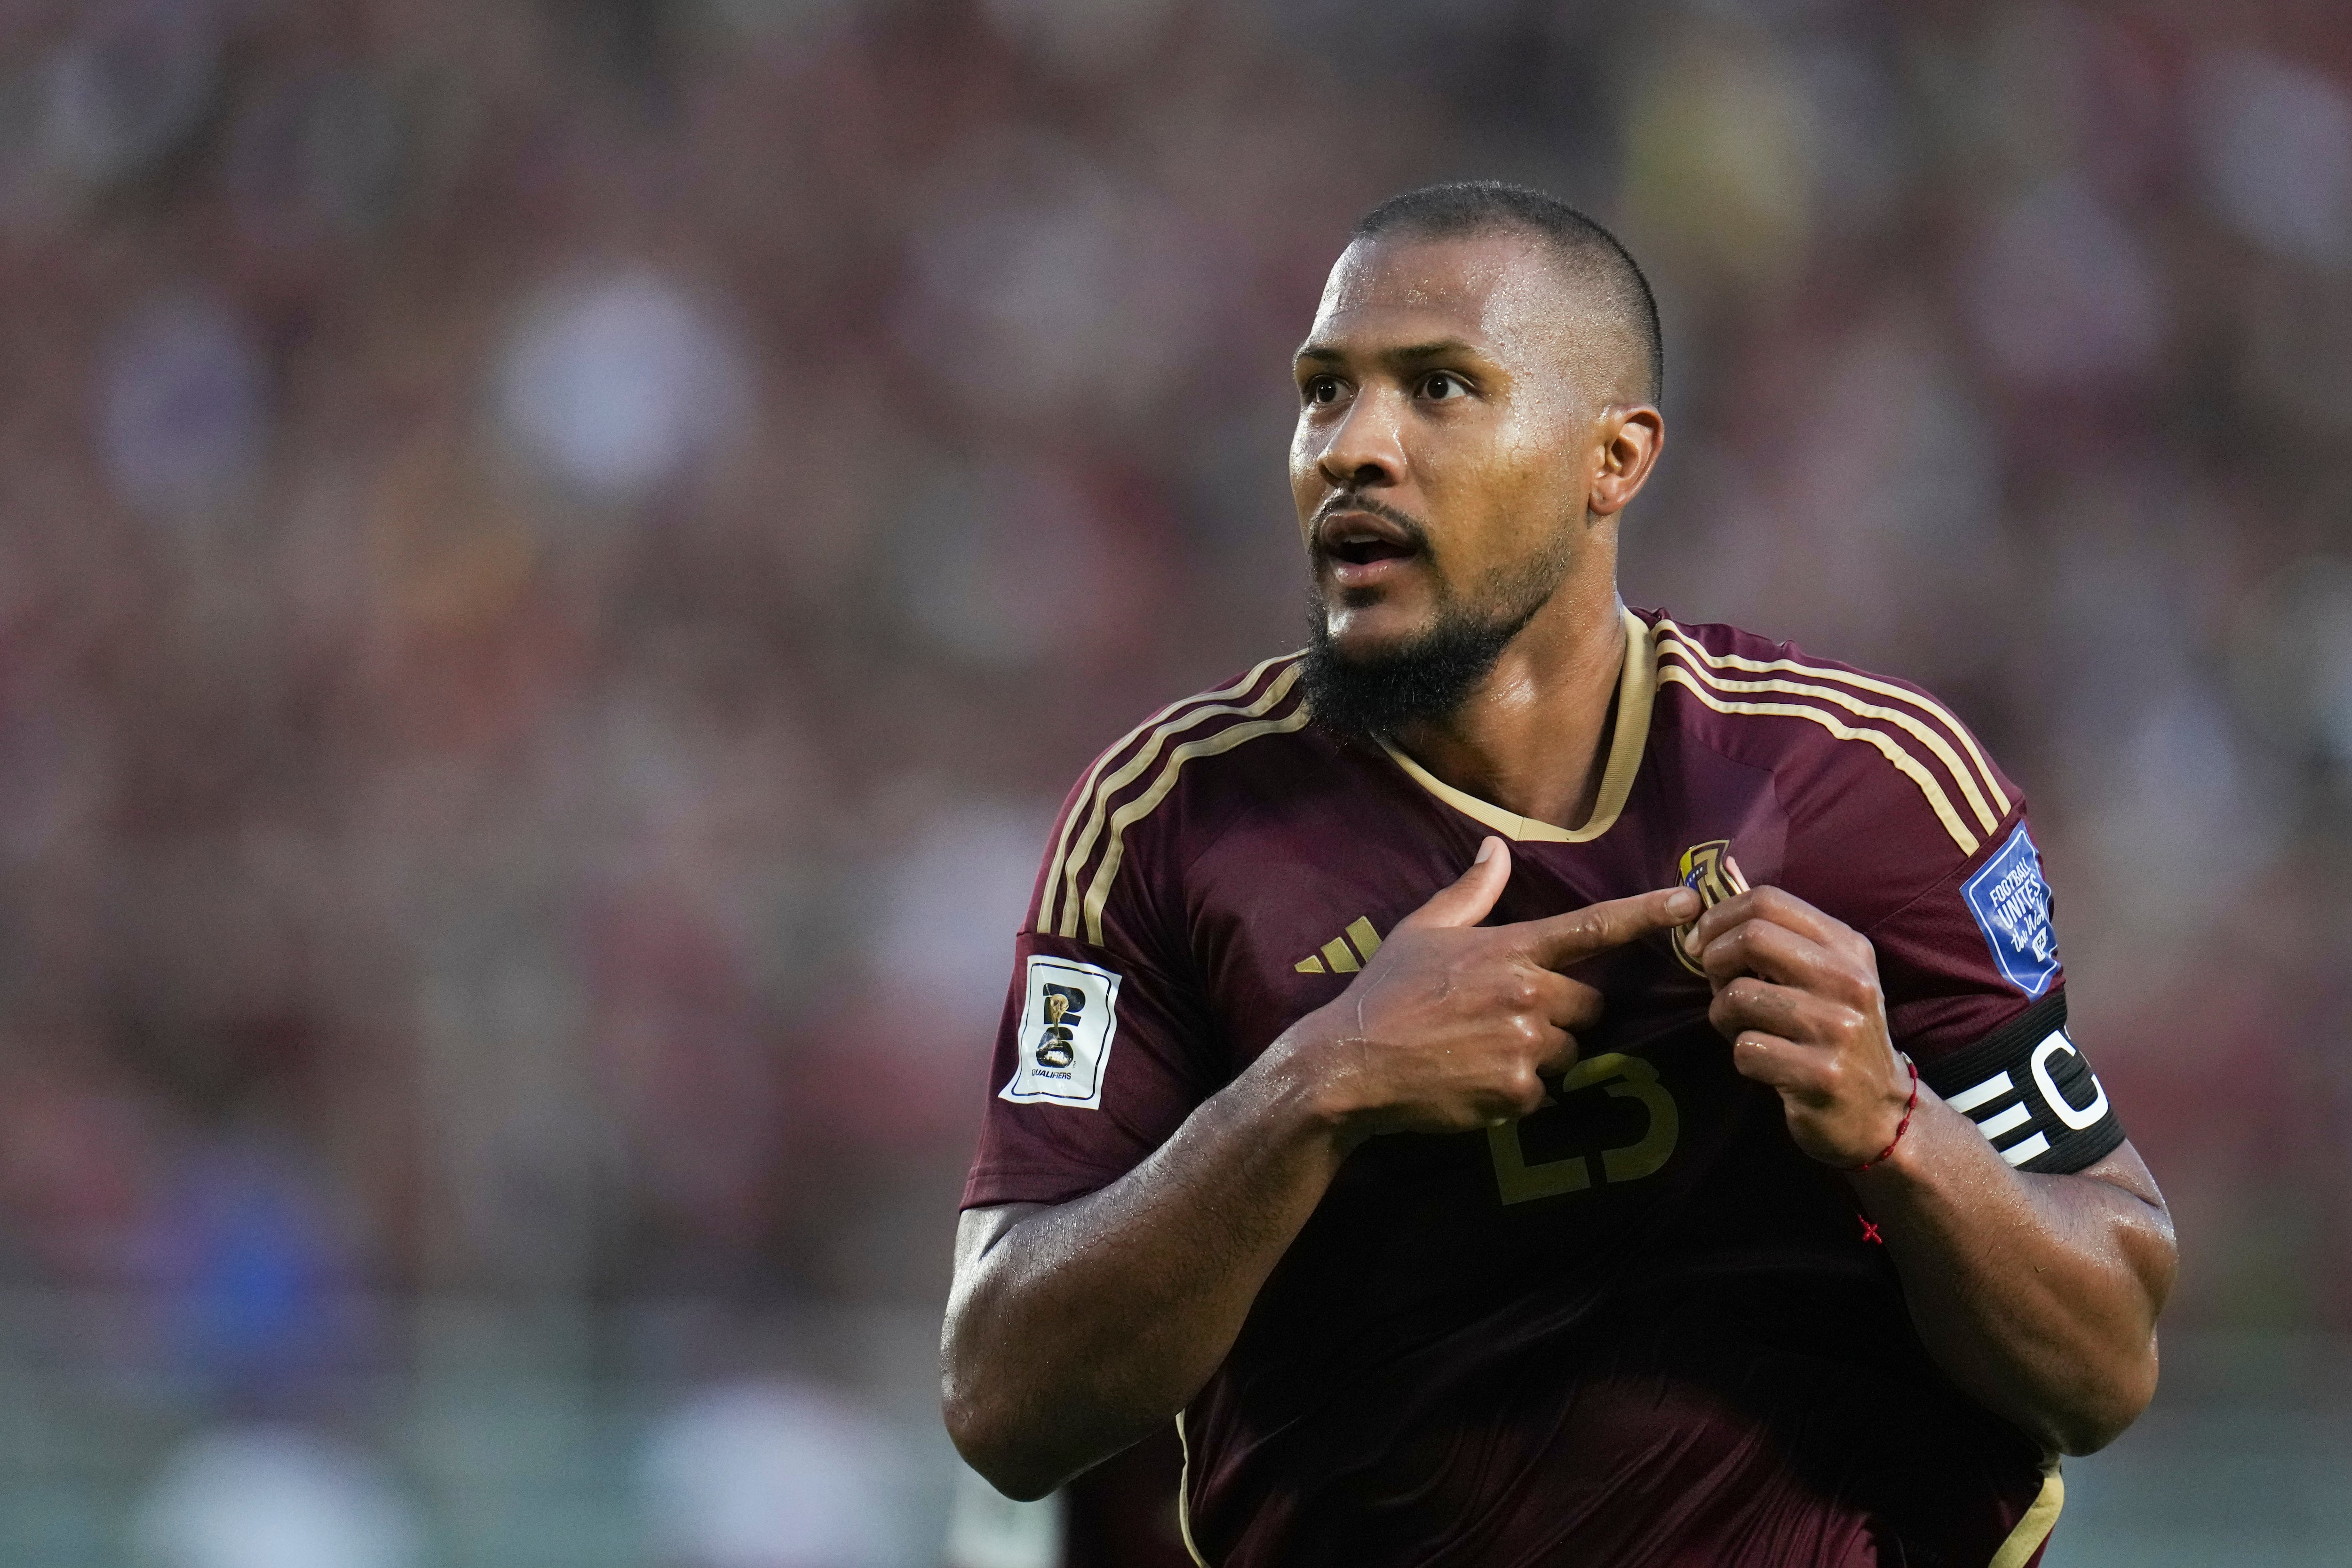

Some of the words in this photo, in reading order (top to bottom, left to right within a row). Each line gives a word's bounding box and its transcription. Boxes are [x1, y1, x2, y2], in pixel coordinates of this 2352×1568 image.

[1989, 857, 2031, 908] FOOTBALL
[1997, 873, 2041, 930] UNITES
[2010, 928, 2028, 953] the
[1032, 1069, 1071, 1080] QUALIFIERS
[1945, 1025, 2109, 1166] EC
